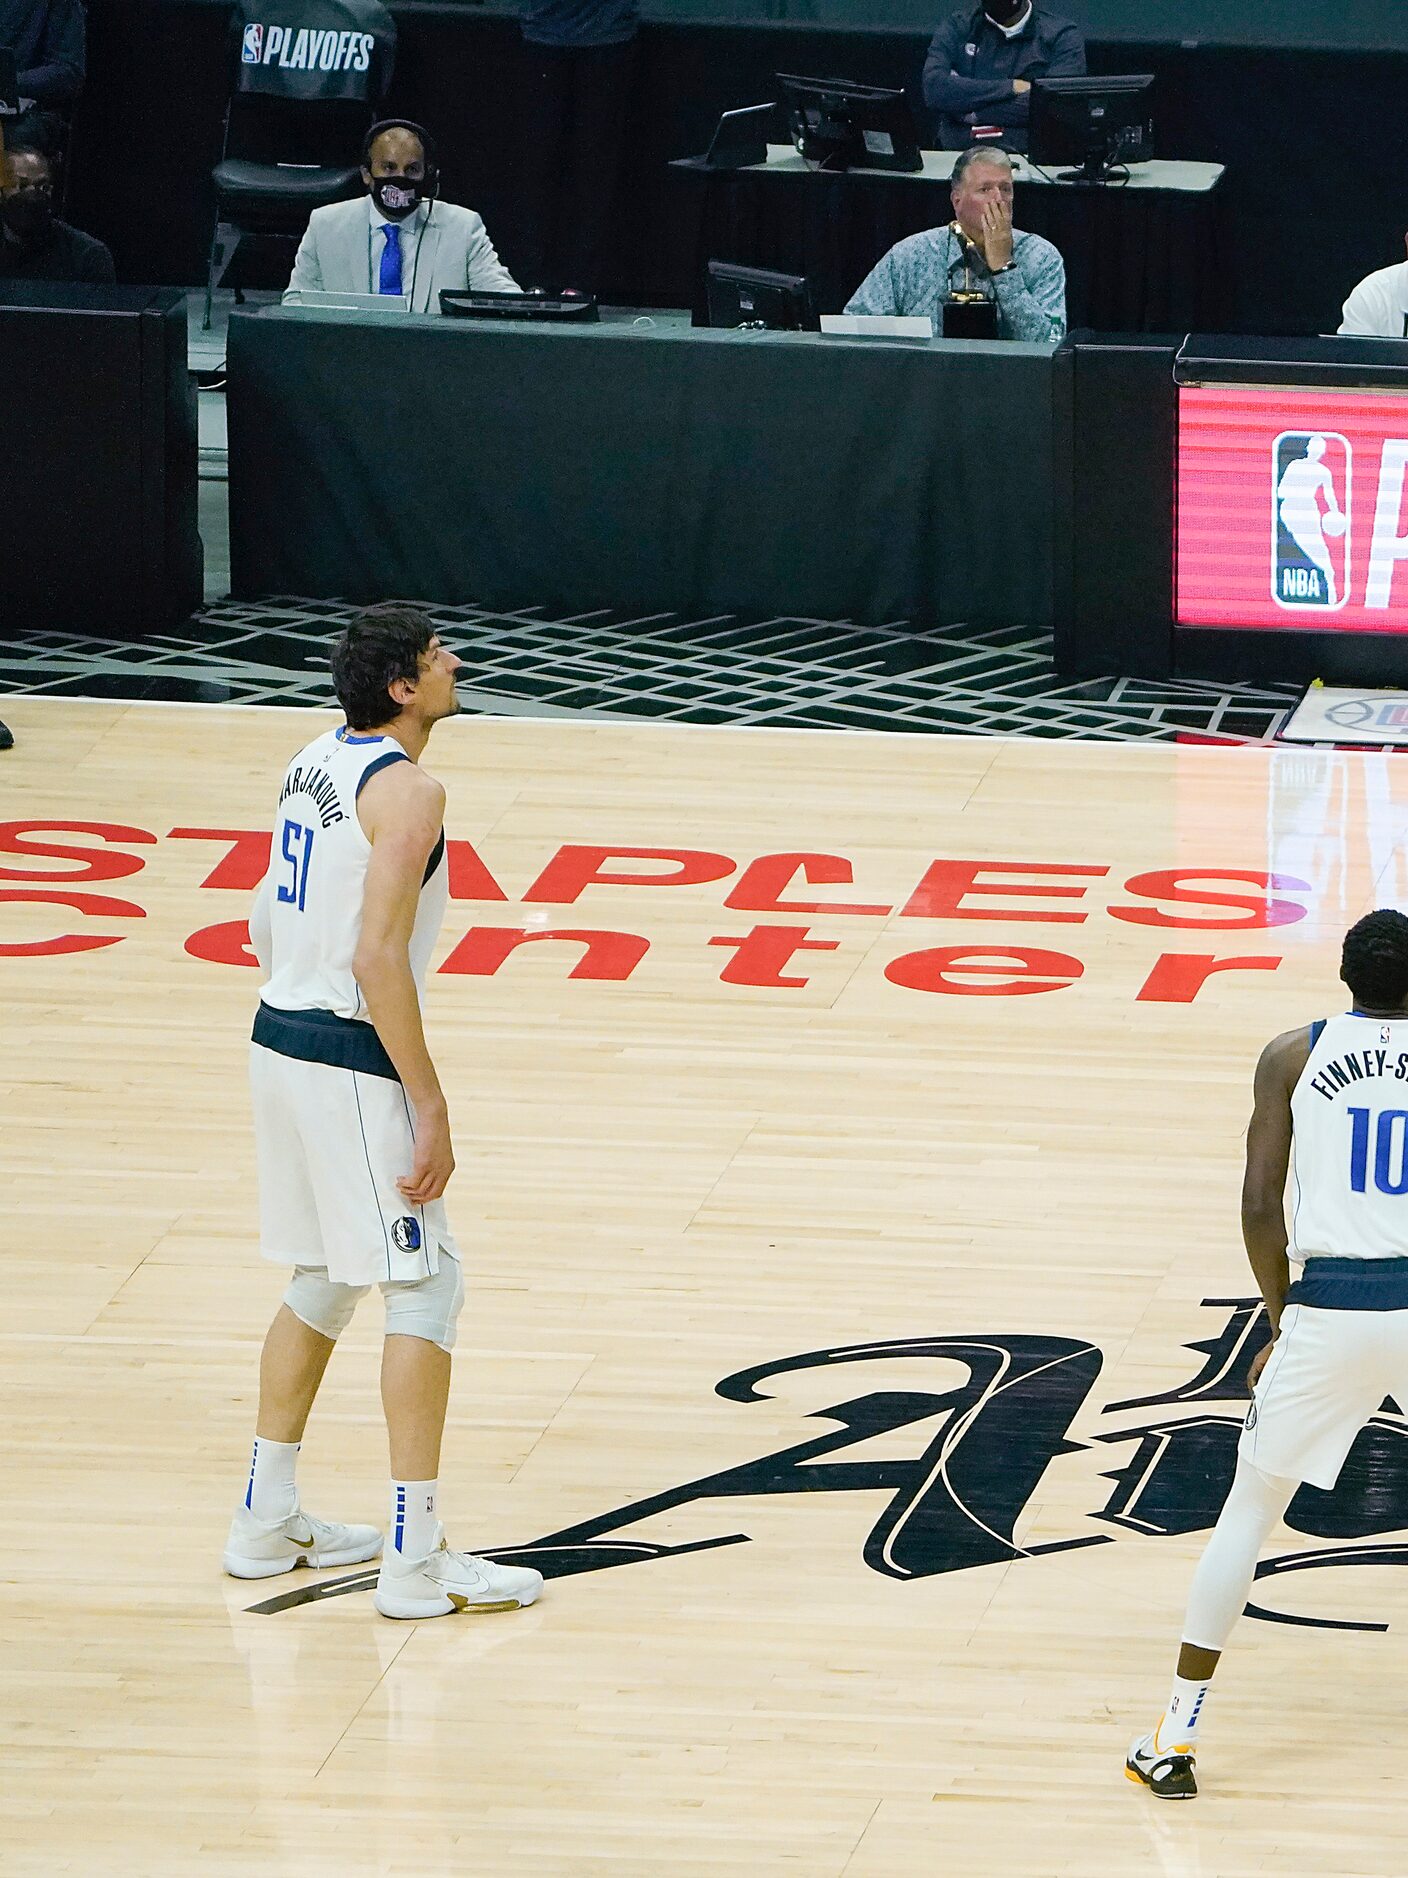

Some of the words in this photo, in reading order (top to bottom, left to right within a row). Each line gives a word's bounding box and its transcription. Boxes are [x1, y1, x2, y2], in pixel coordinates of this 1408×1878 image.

[262, 25, 375, 71] PLAYOFFS
[1282, 566, 1321, 597] NBA
[279, 766, 350, 829] ARJANOVIĆ
[277, 818, 315, 913] 51
